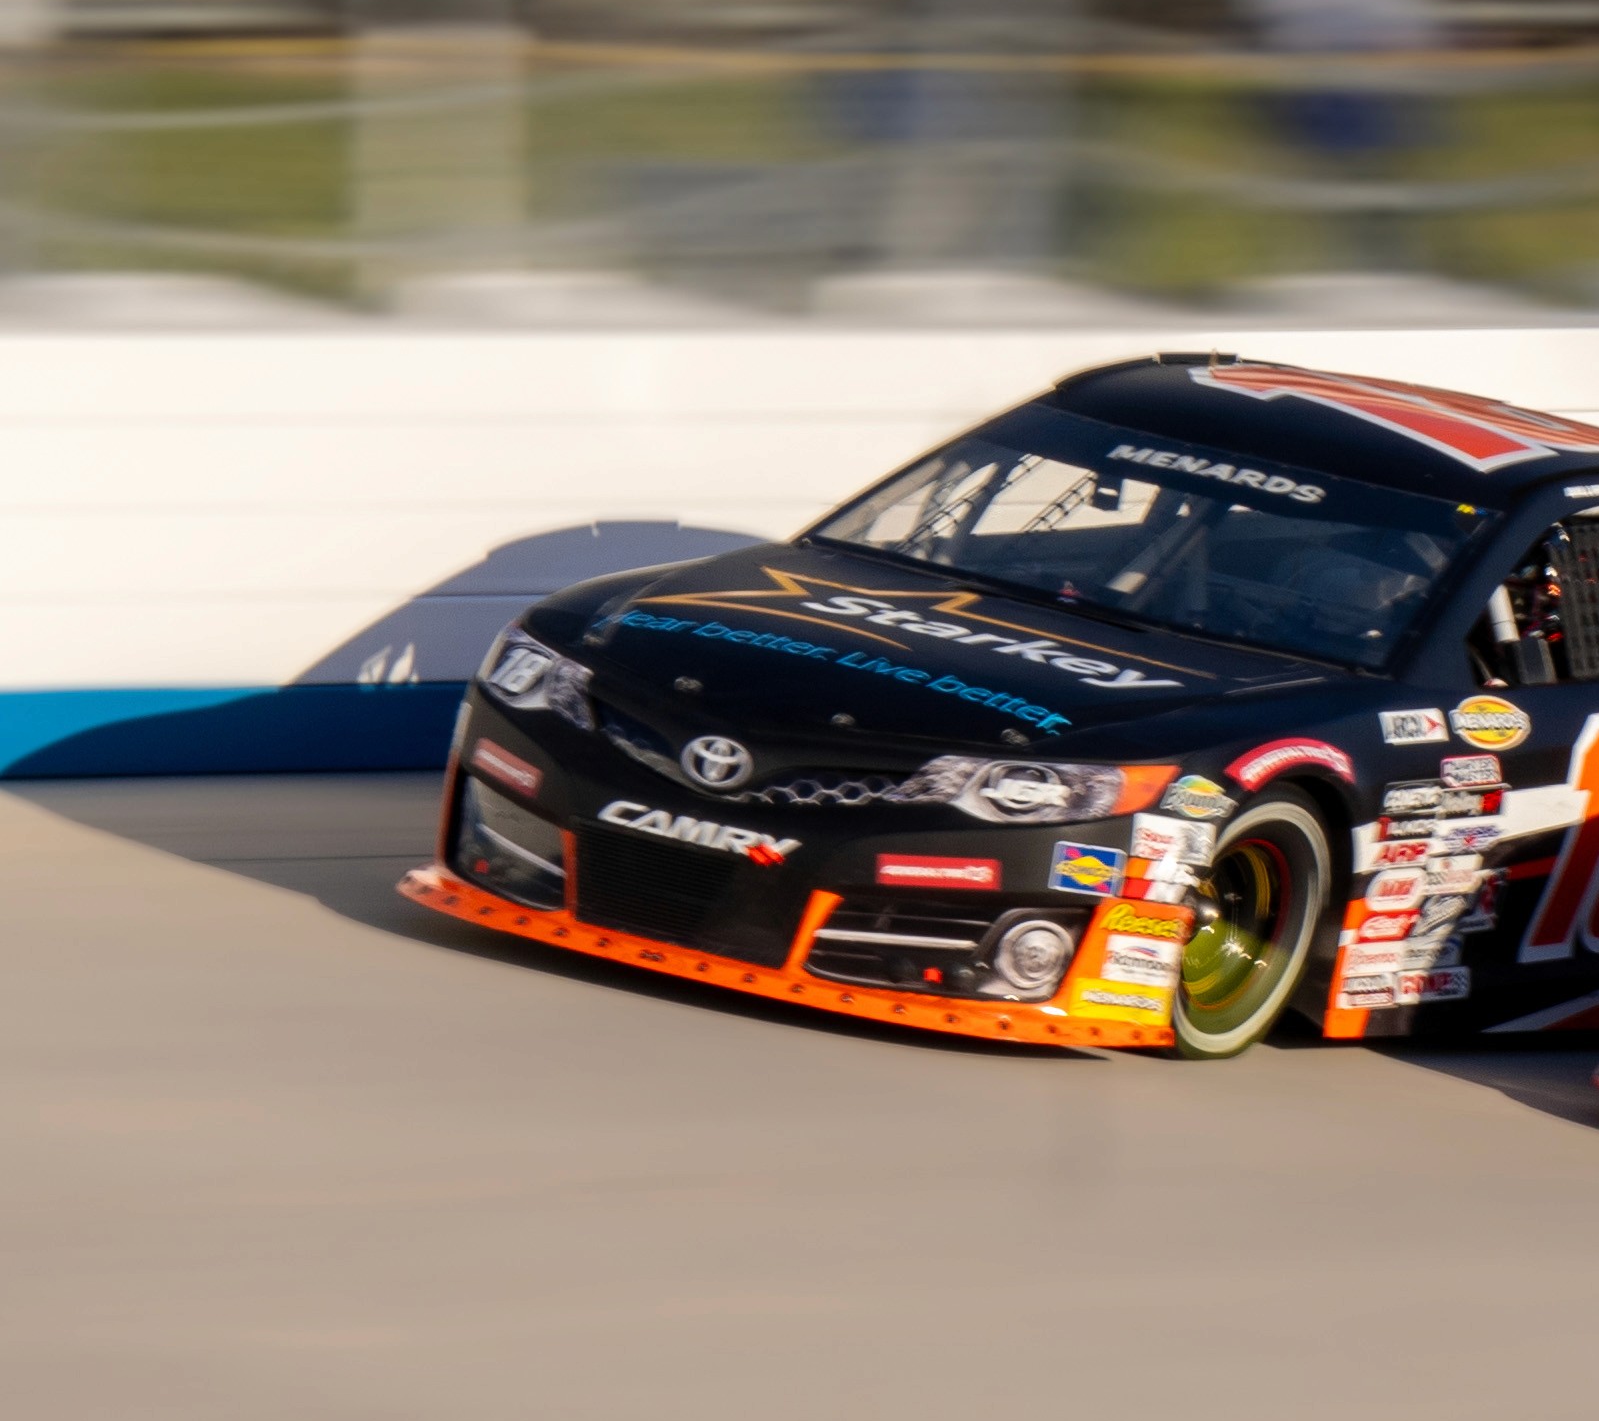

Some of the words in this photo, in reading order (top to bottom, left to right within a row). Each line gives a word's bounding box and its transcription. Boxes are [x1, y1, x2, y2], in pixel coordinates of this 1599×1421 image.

[1106, 444, 1327, 503] MENARDS
[802, 596, 1185, 690] Starkey
[836, 651, 930, 684] Live
[926, 674, 1073, 736] better.
[597, 800, 803, 858] CAMRY
